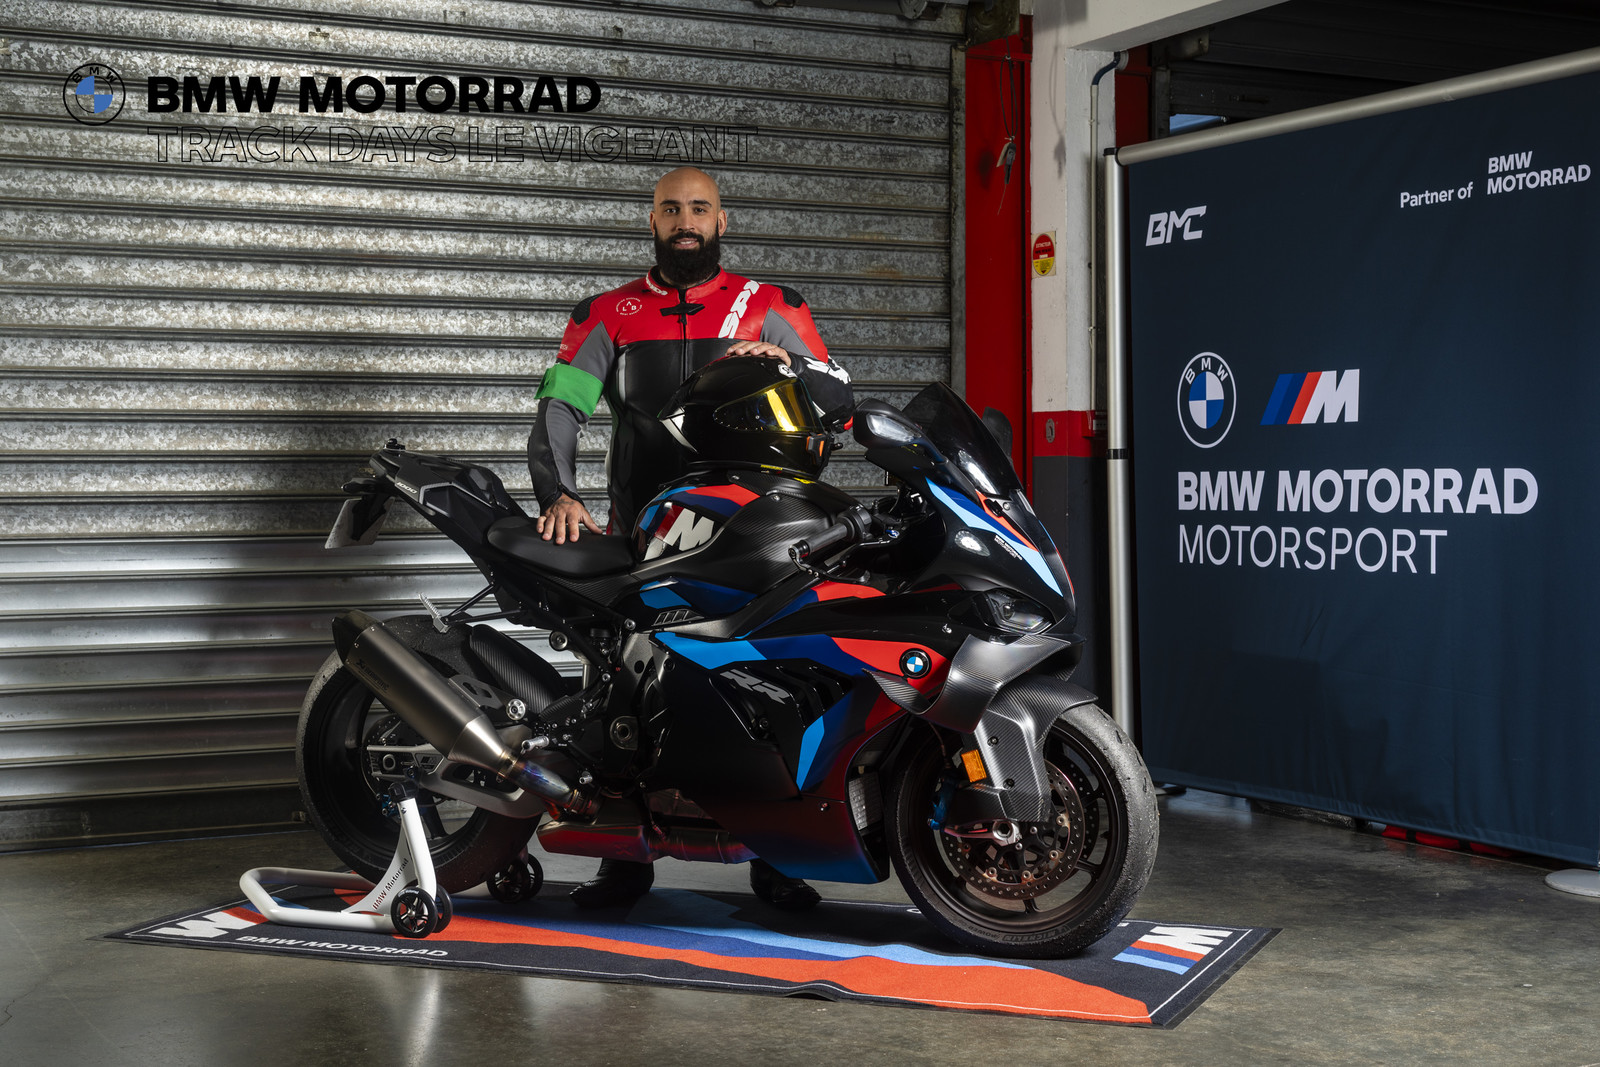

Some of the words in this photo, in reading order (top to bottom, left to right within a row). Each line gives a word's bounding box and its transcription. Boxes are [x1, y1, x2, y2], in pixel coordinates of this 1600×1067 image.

[1488, 151, 1533, 174] BMW
[1400, 189, 1455, 208] Partner
[1457, 181, 1474, 200] of
[1487, 164, 1591, 195] MOTORRAD
[1145, 205, 1207, 247] BMC
[1185, 357, 1228, 384] BMW
[1300, 368, 1360, 425] M
[397, 482, 418, 494] 1000
[1178, 470, 1265, 511] BMW
[1277, 468, 1539, 515] MOTORRAD
[1179, 524, 1448, 574] MOTORSPORT
[720, 668, 791, 705] RR
[236, 935, 305, 946] BMW
[304, 941, 448, 957] MOTORRAD
